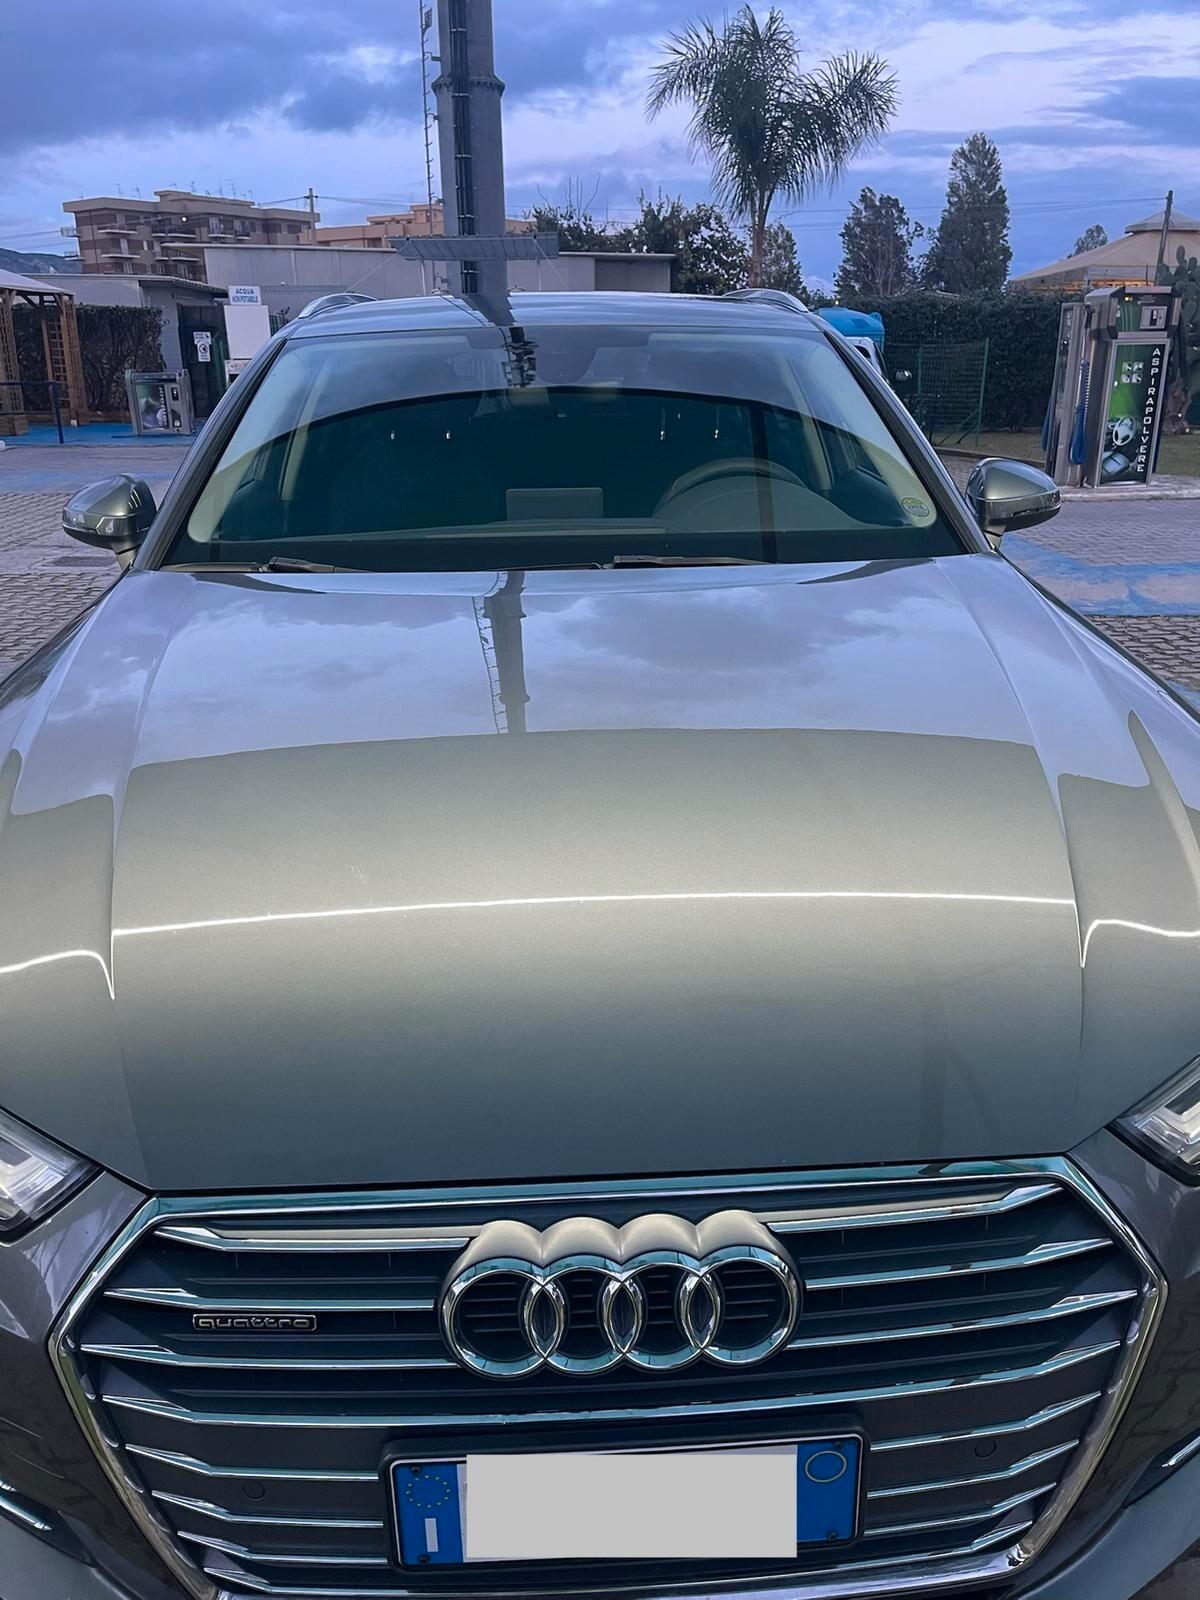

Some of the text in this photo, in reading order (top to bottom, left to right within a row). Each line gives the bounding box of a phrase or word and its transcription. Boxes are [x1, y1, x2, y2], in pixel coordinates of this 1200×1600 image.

[1137, 348, 1161, 472] ASPIRAPOLVERE
[198, 1317, 310, 1329] quattro
[424, 1517, 439, 1553] I
